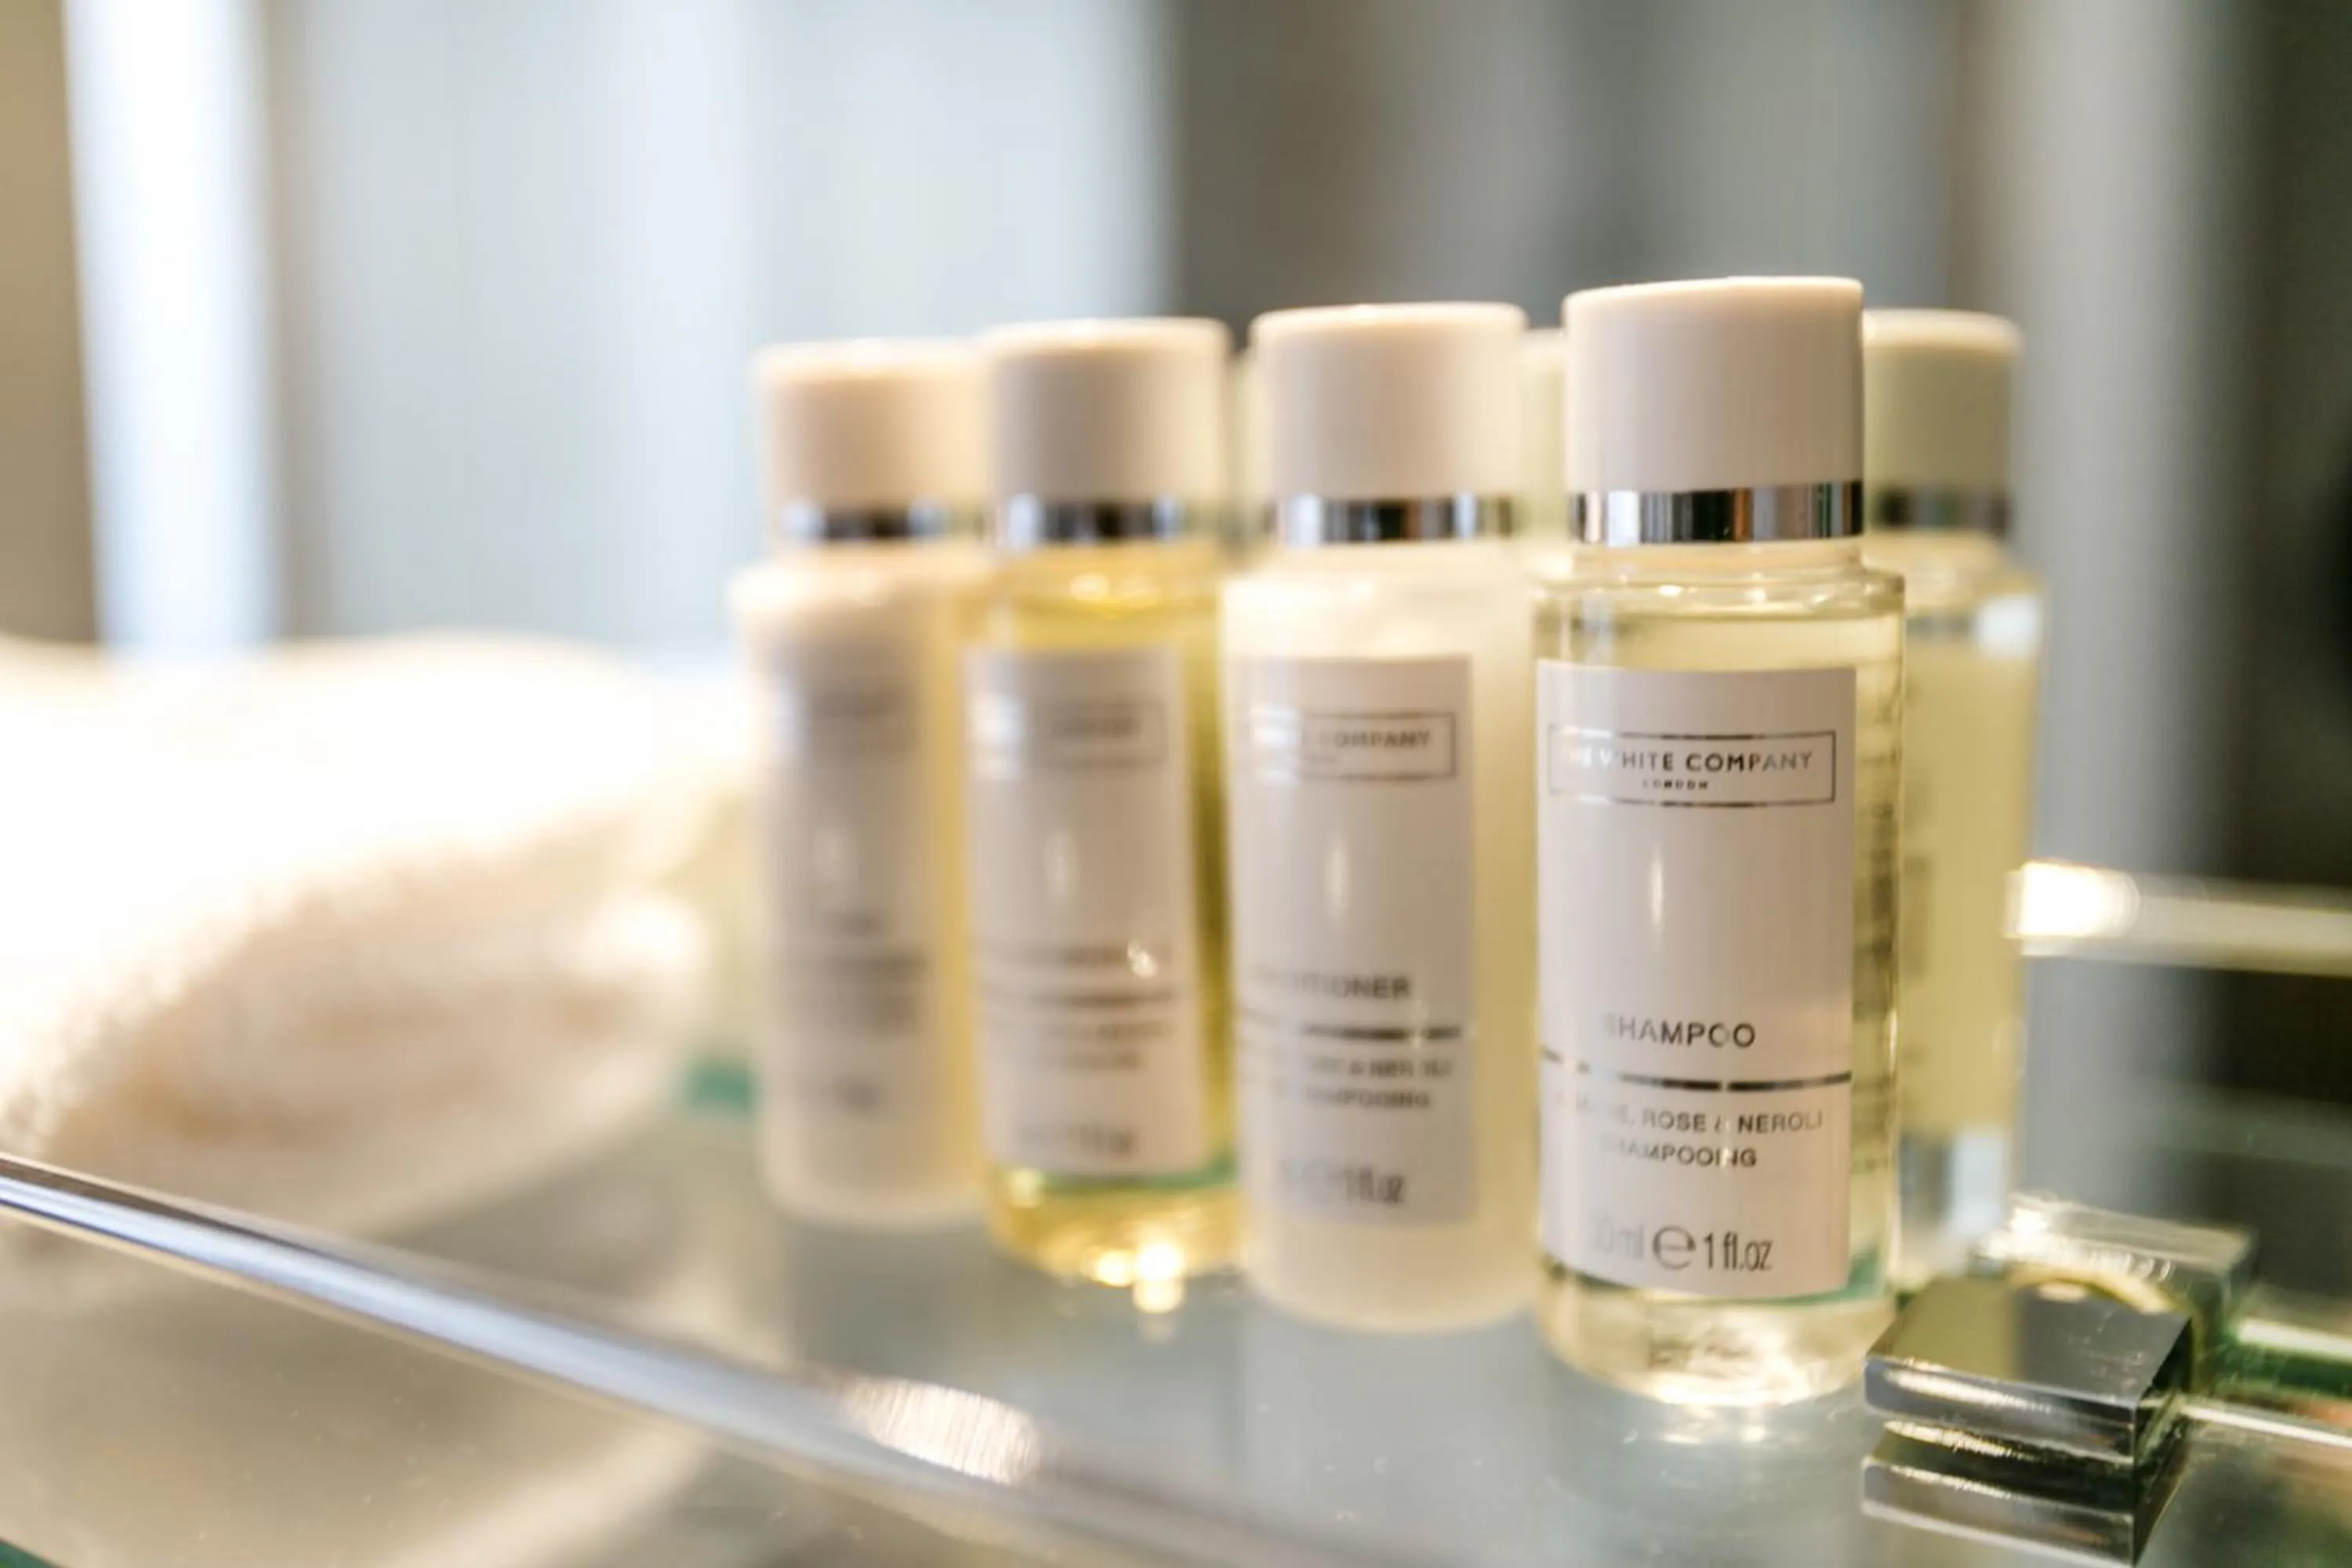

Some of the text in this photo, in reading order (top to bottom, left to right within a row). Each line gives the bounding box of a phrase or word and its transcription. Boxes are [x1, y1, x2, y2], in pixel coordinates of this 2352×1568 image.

[1686, 750, 1814, 774] COMPANY
[1642, 1108, 1707, 1134] ROSE
[1737, 1110, 1823, 1134] NEROLI
